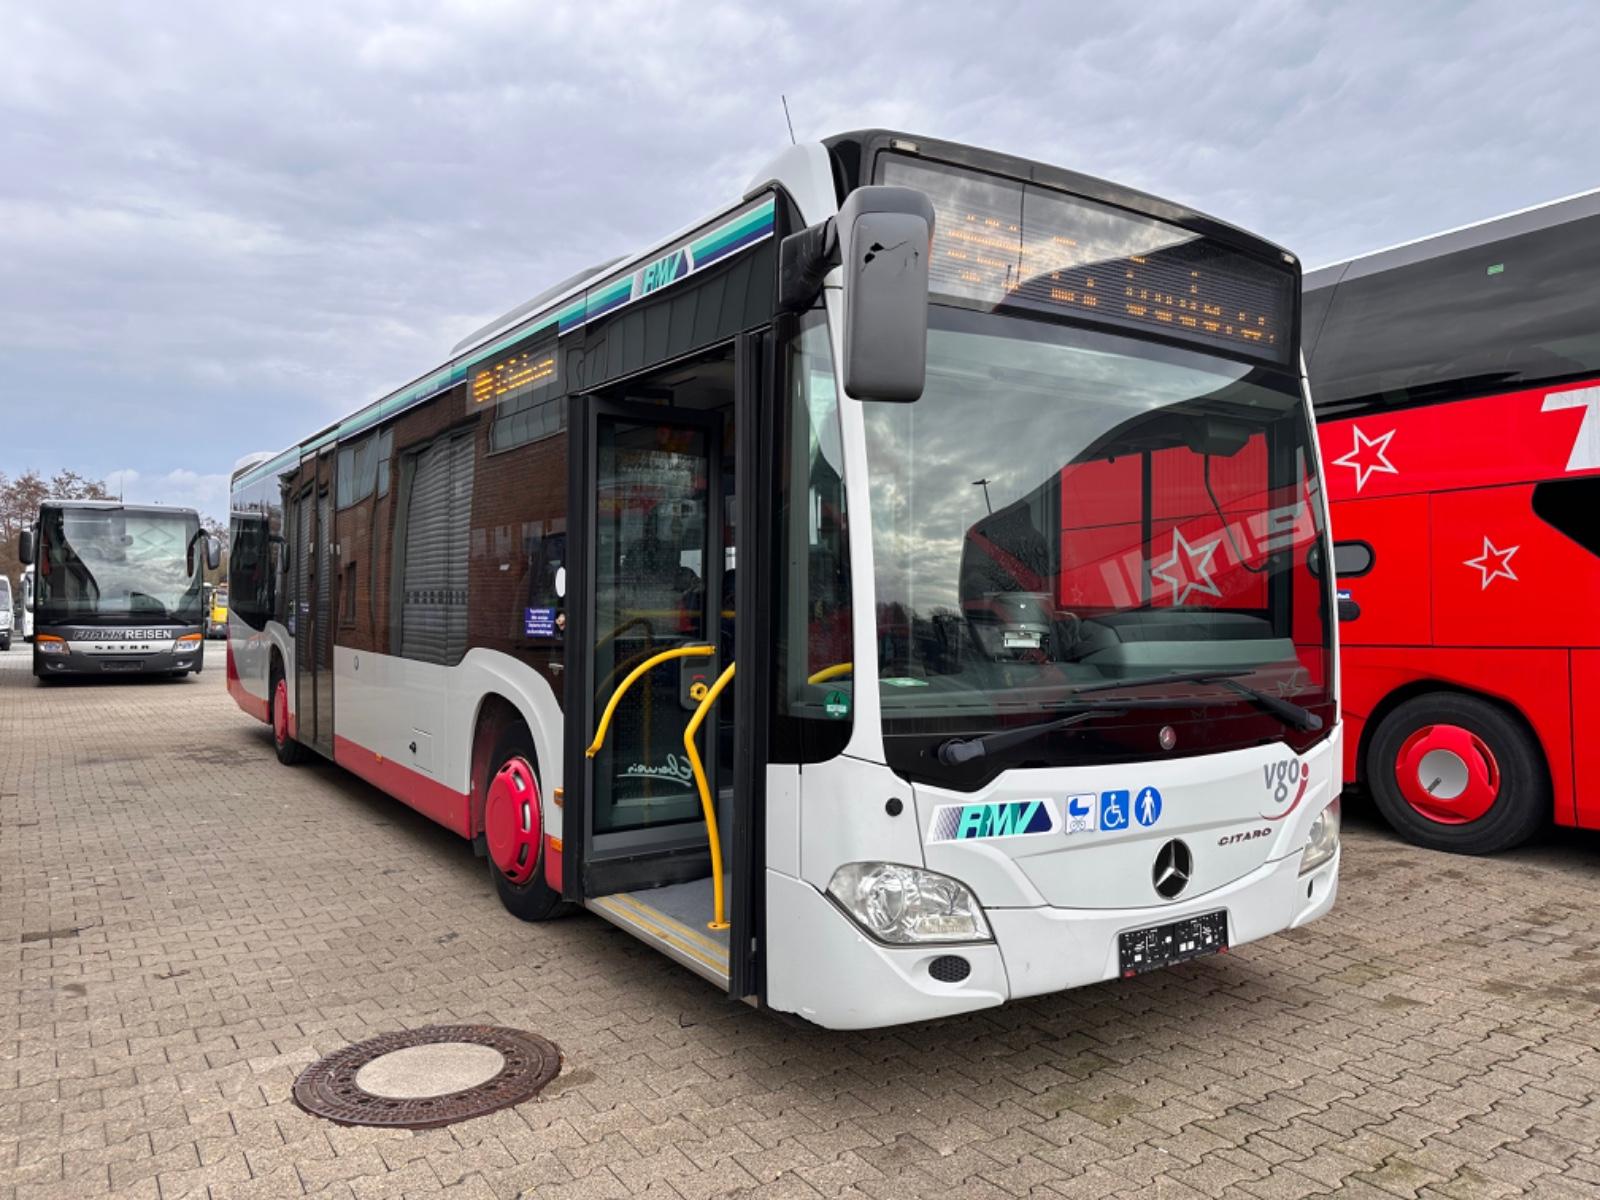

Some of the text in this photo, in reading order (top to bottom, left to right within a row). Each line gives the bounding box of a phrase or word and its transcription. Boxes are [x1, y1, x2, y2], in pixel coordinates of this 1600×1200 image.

[125, 630, 172, 639] REISEN
[1263, 758, 1300, 803] vgo
[956, 800, 1041, 840] RMV
[1217, 827, 1272, 847] CITARO
